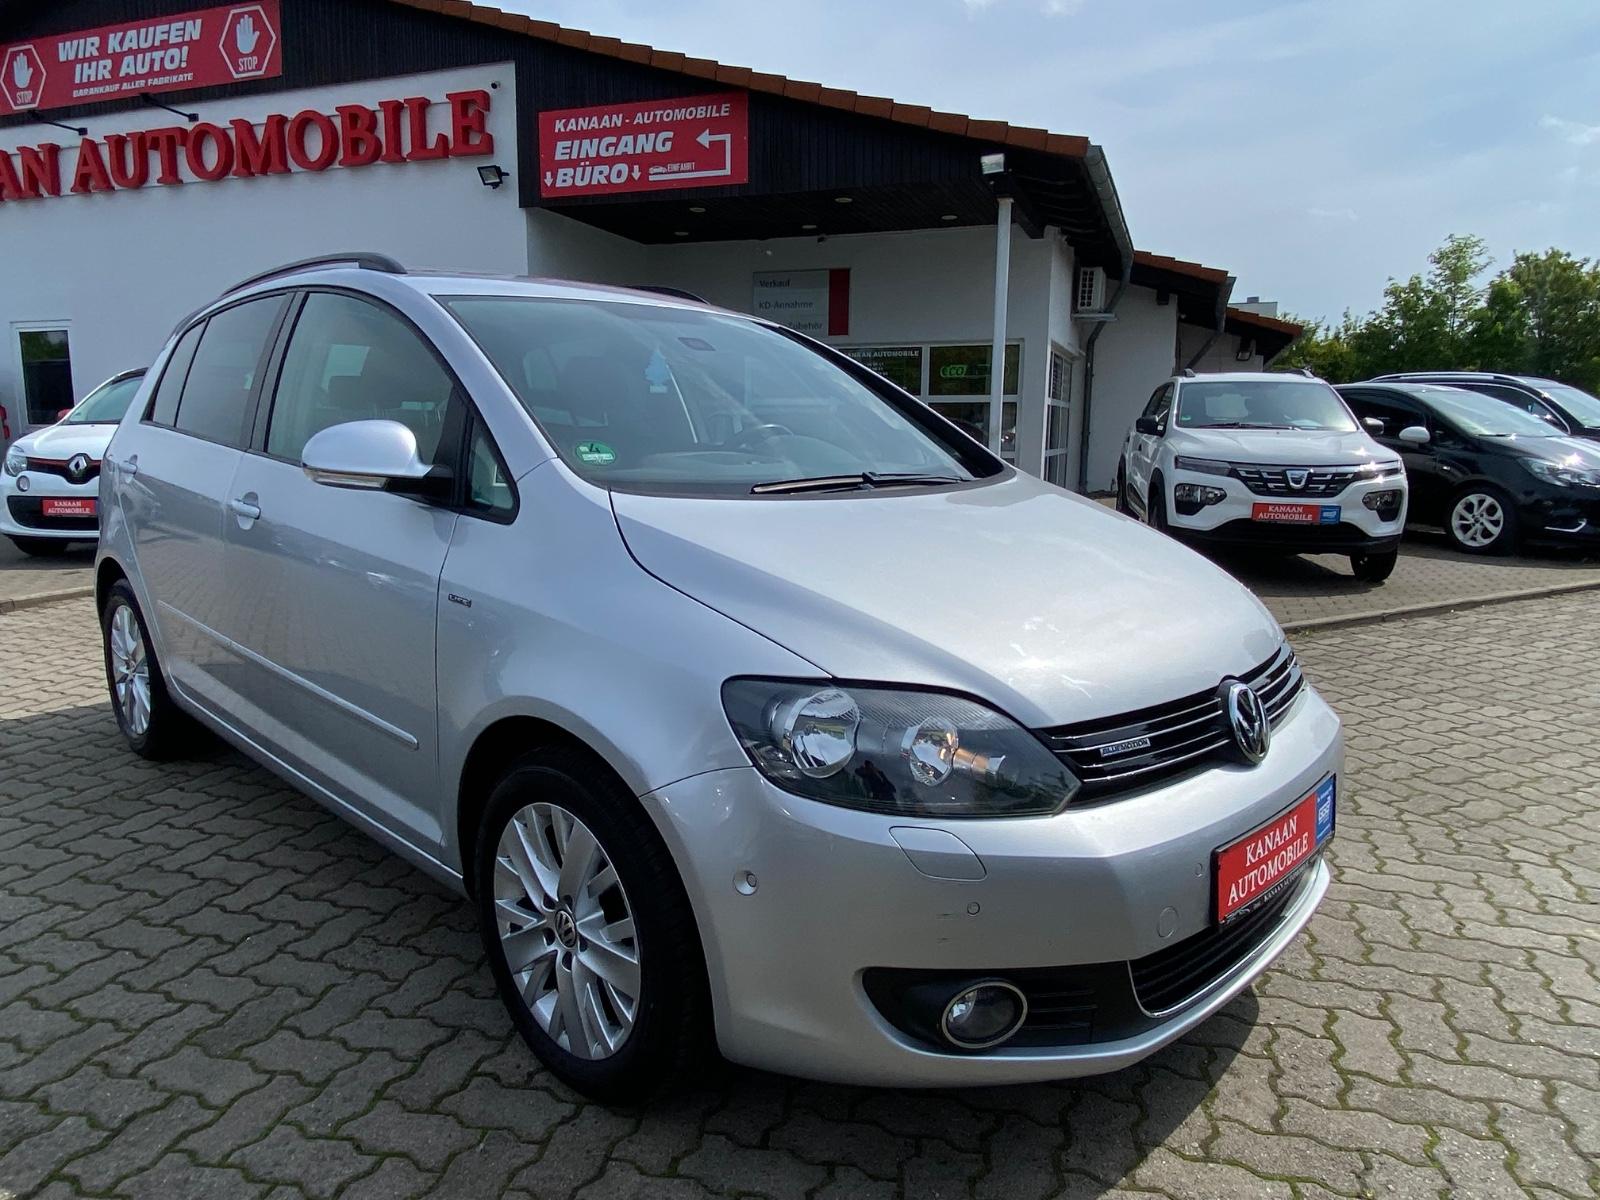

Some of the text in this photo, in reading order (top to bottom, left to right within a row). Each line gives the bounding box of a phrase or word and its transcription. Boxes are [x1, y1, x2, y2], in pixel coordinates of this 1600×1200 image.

[58, 19, 202, 63] WIR KAUFEN
[74, 46, 189, 84] IHR AUTO!
[238, 56, 259, 72] STOP
[121, 79, 146, 91] ALLER
[148, 72, 194, 87] FABRIKATE
[554, 113, 623, 133] KANAAN
[633, 103, 731, 125] AUTOMOBILE
[70, 89, 495, 194] AUTOMOBILE
[554, 131, 674, 161] EINGANG
[555, 161, 629, 188] BÜRO
[759, 279, 791, 289] Verkauf
[1258, 511, 1313, 521] AUTOMOBILE
[1268, 505, 1304, 513] KANAAN
[1245, 815, 1298, 867] KANAAN
[1227, 831, 1309, 907] AUTOMOBILE
